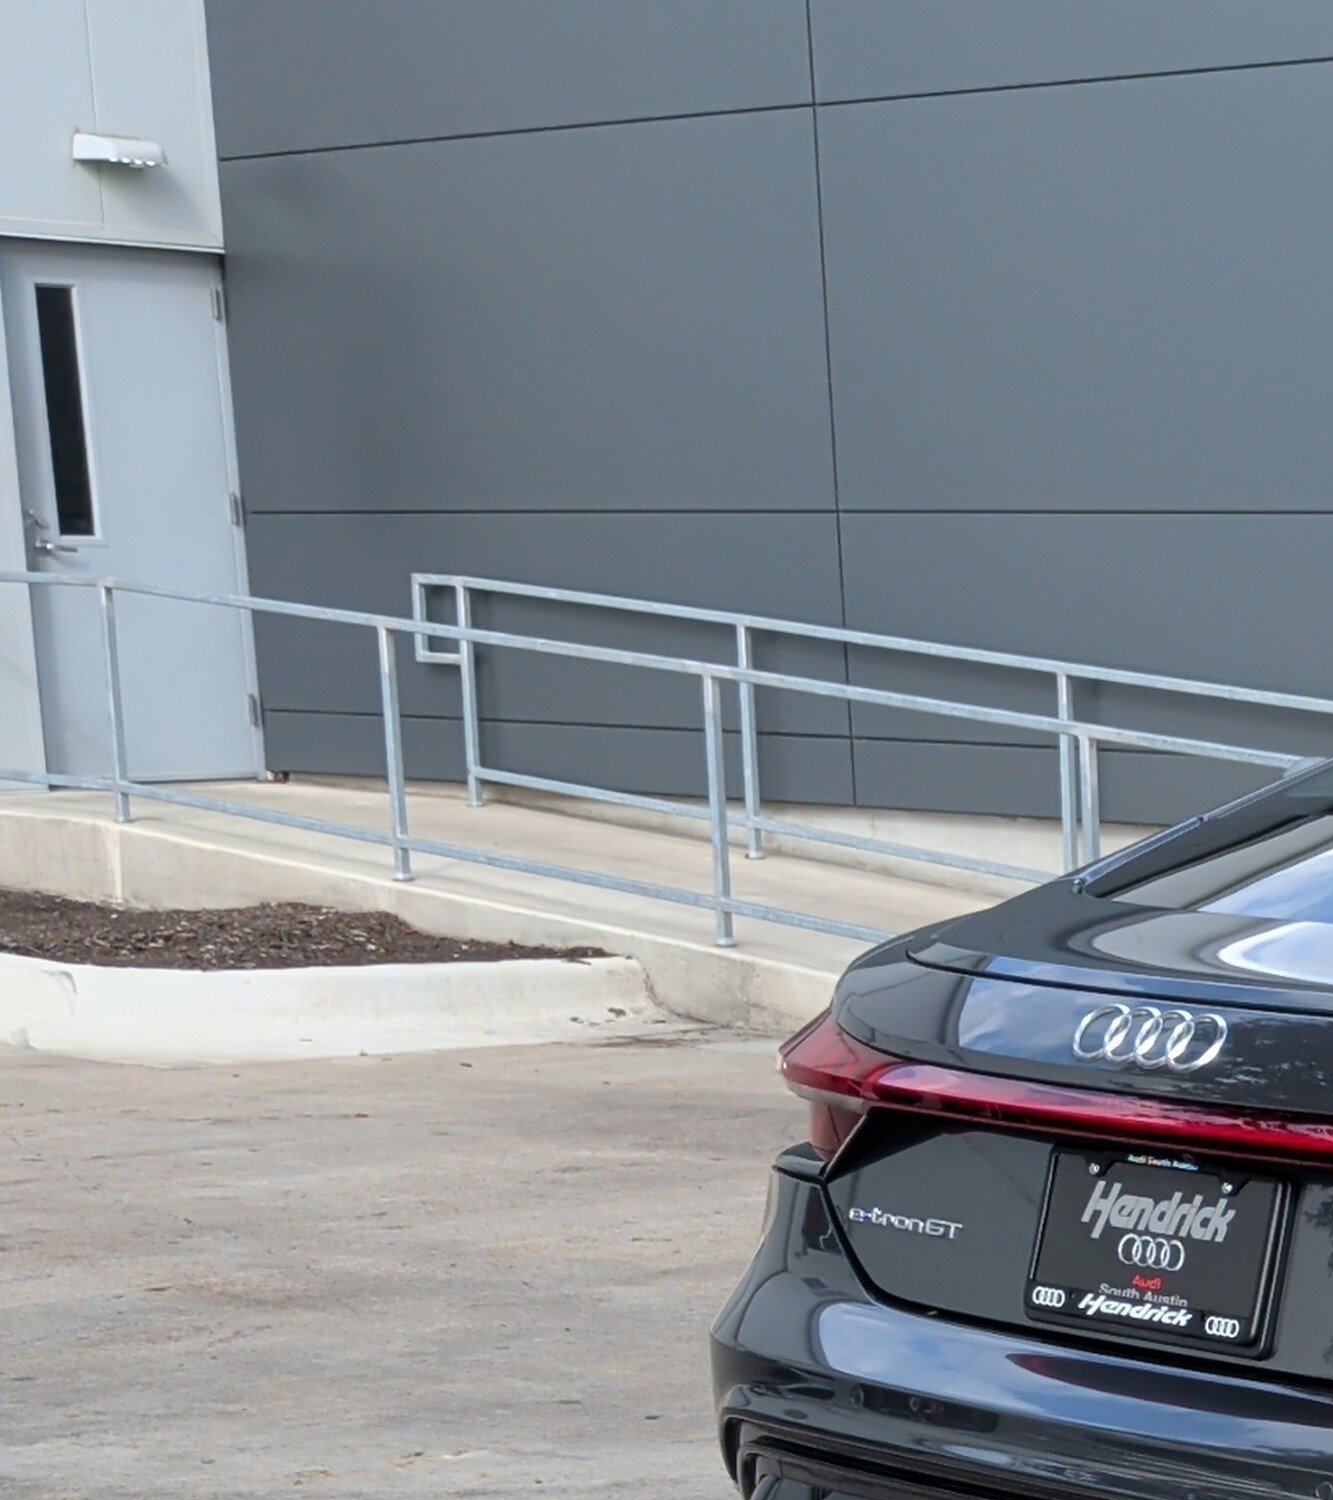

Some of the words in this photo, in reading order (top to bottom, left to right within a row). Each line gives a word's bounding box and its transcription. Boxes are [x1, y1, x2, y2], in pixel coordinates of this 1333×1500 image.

[1081, 1180, 1236, 1242] Hendrick
[1099, 1283, 1140, 1300] South
[1143, 1291, 1188, 1308] Austin
[1132, 1274, 1162, 1290] Audi
[1078, 1293, 1193, 1327] Hendrick
